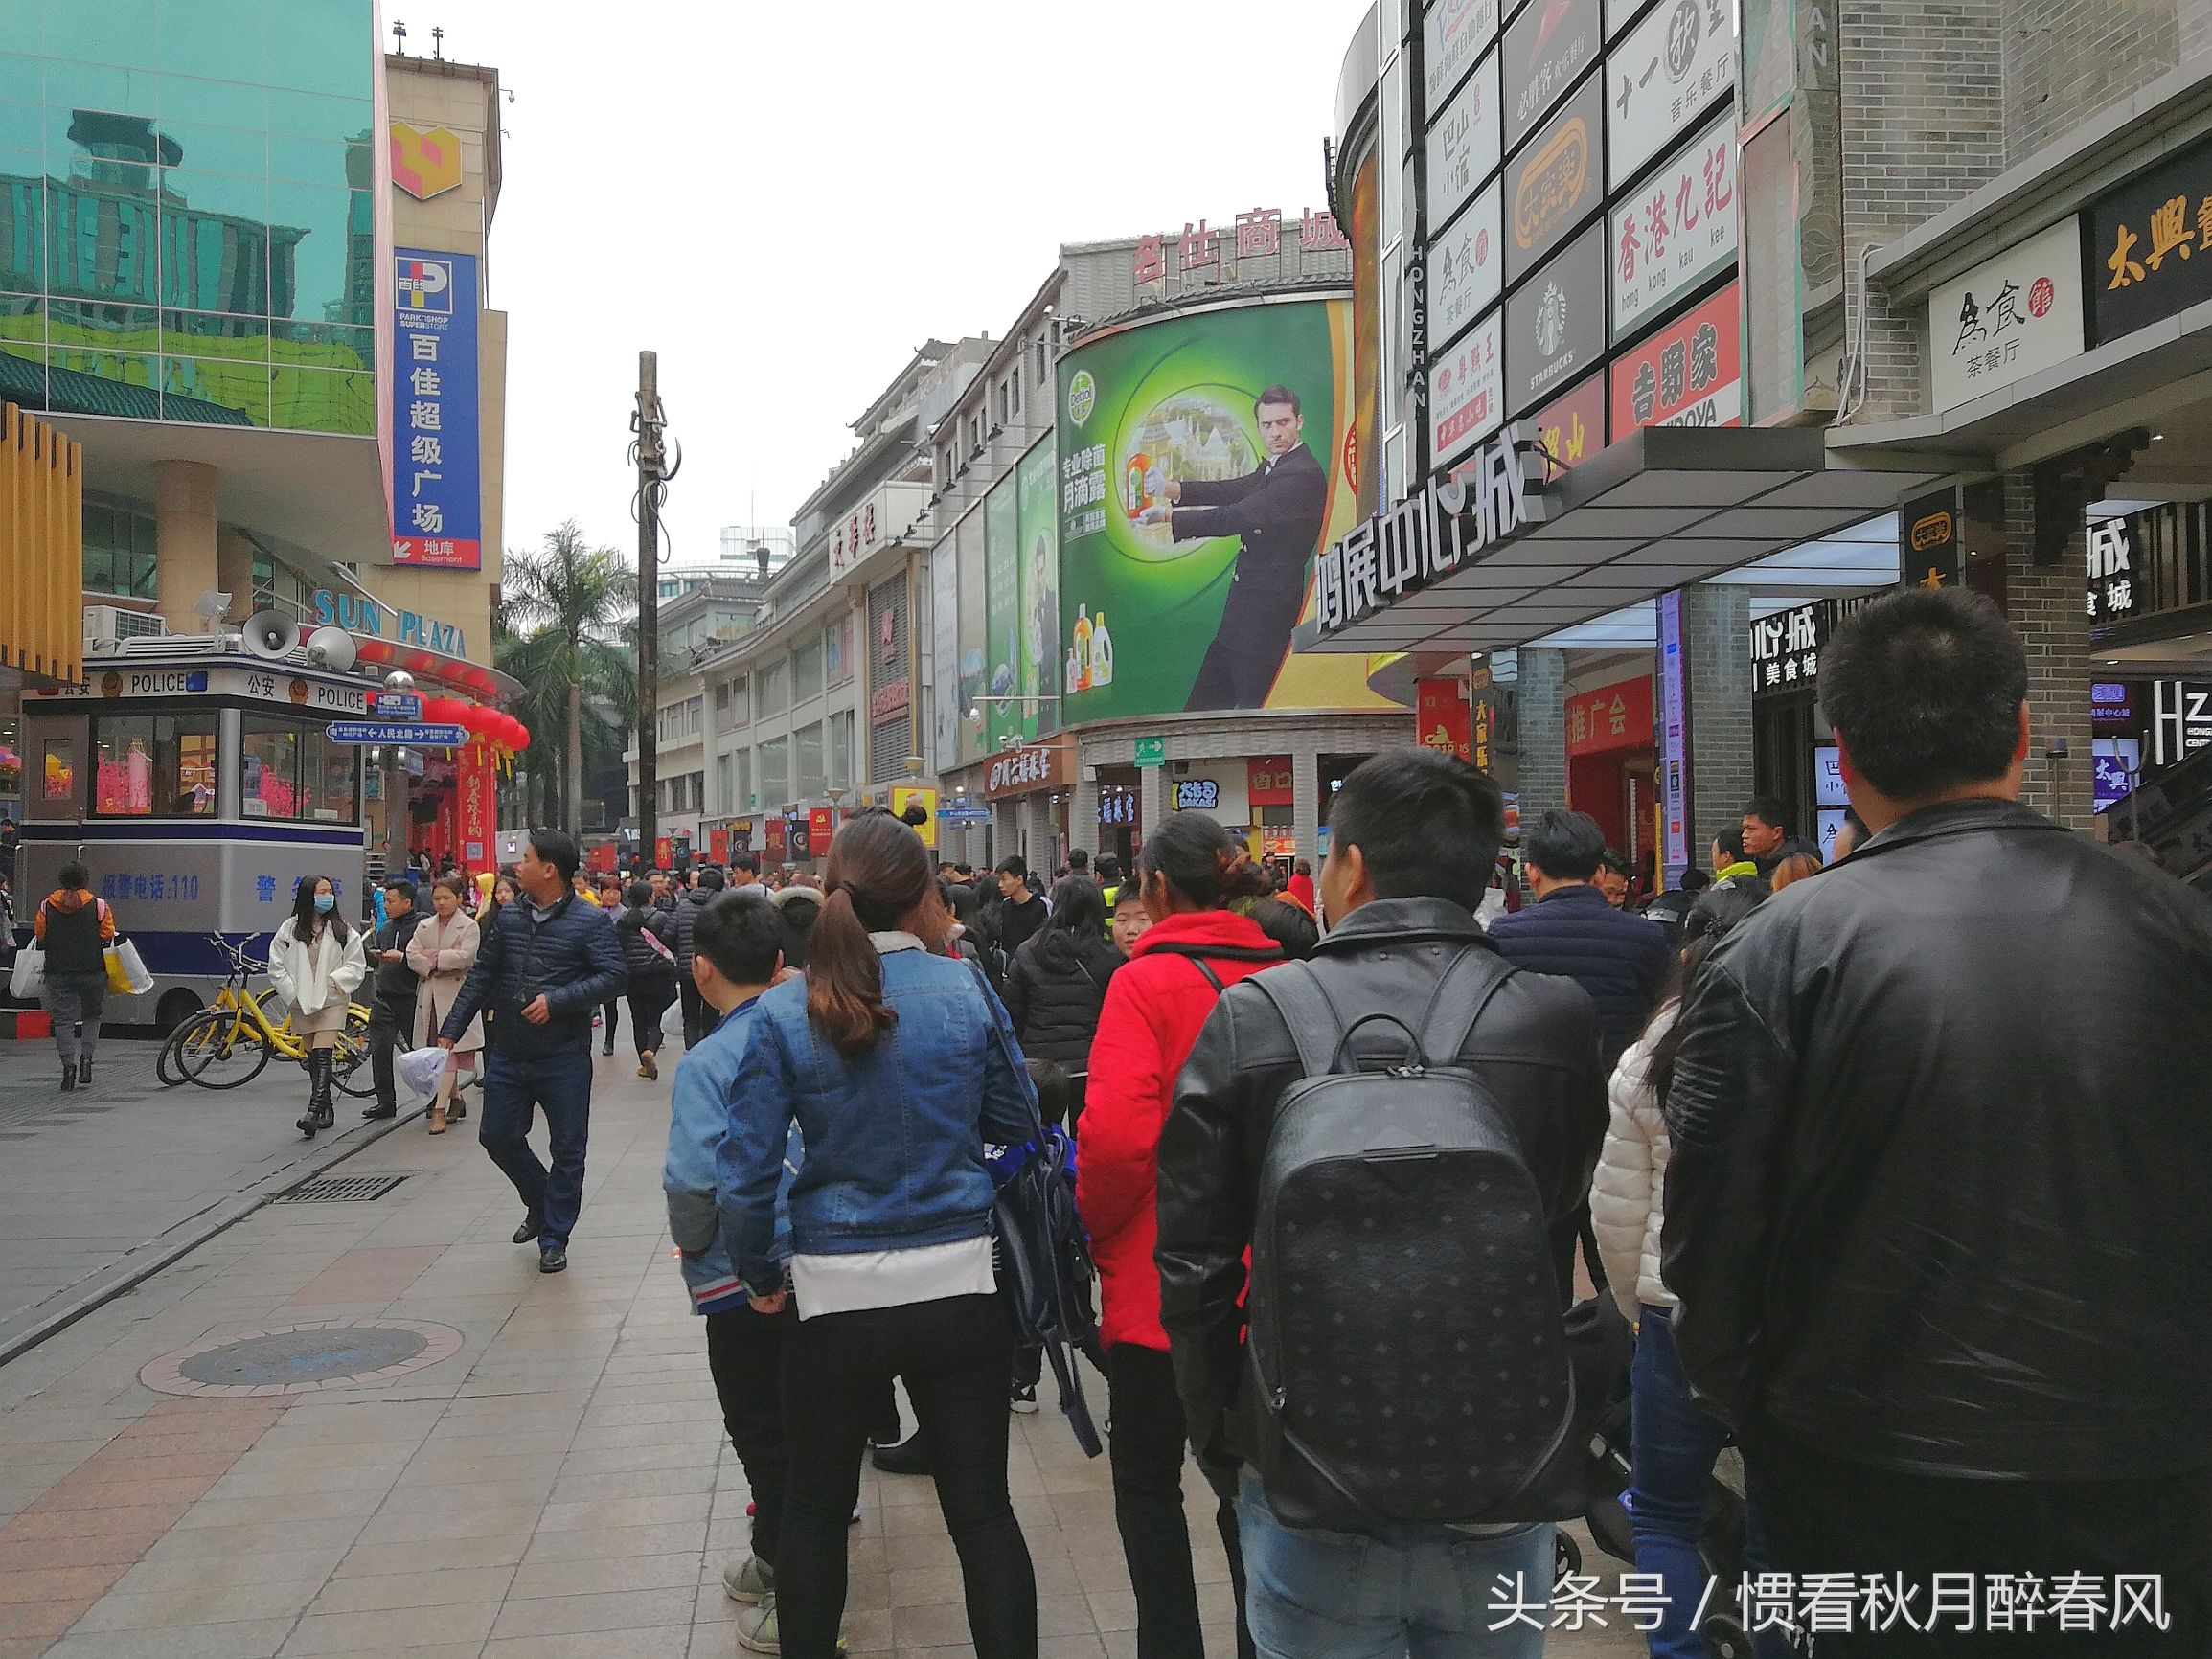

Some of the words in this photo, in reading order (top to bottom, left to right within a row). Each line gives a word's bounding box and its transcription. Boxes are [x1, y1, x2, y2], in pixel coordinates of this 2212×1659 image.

[1671, 52, 1728, 123] 音乐餐厅
[1618, 143, 1733, 284] 香港九記
[1133, 207, 1348, 284] 名仕商城
[1621, 288, 1639, 312] hong
[1648, 268, 1667, 292] kong
[1678, 247, 1694, 270] kau
[1710, 225, 1725, 247] kee
[1410, 244, 1426, 410] HONGZHAN
[1530, 351, 1574, 390] STARBUCKS
[1967, 338, 2020, 379] 茶餐厅
[1071, 385, 1092, 407] Dettol
[409, 333, 443, 534] 百佳超级广场
[1064, 469, 1106, 514] 用滴露
[424, 540, 454, 556] 地库
[1316, 421, 1527, 634] 鸿展中心城
[422, 555, 463, 564] Basement
[316, 589, 382, 636] SUN
[397, 609, 467, 658] PLAZA
[1750, 606, 1817, 661] 心城
[131, 673, 185, 693] POLICE
[247, 674, 275, 697] 公安
[1766, 652, 1817, 687] 美食城
[318, 686, 364, 710] POLICE
[1571, 693, 1626, 744] 推广会
